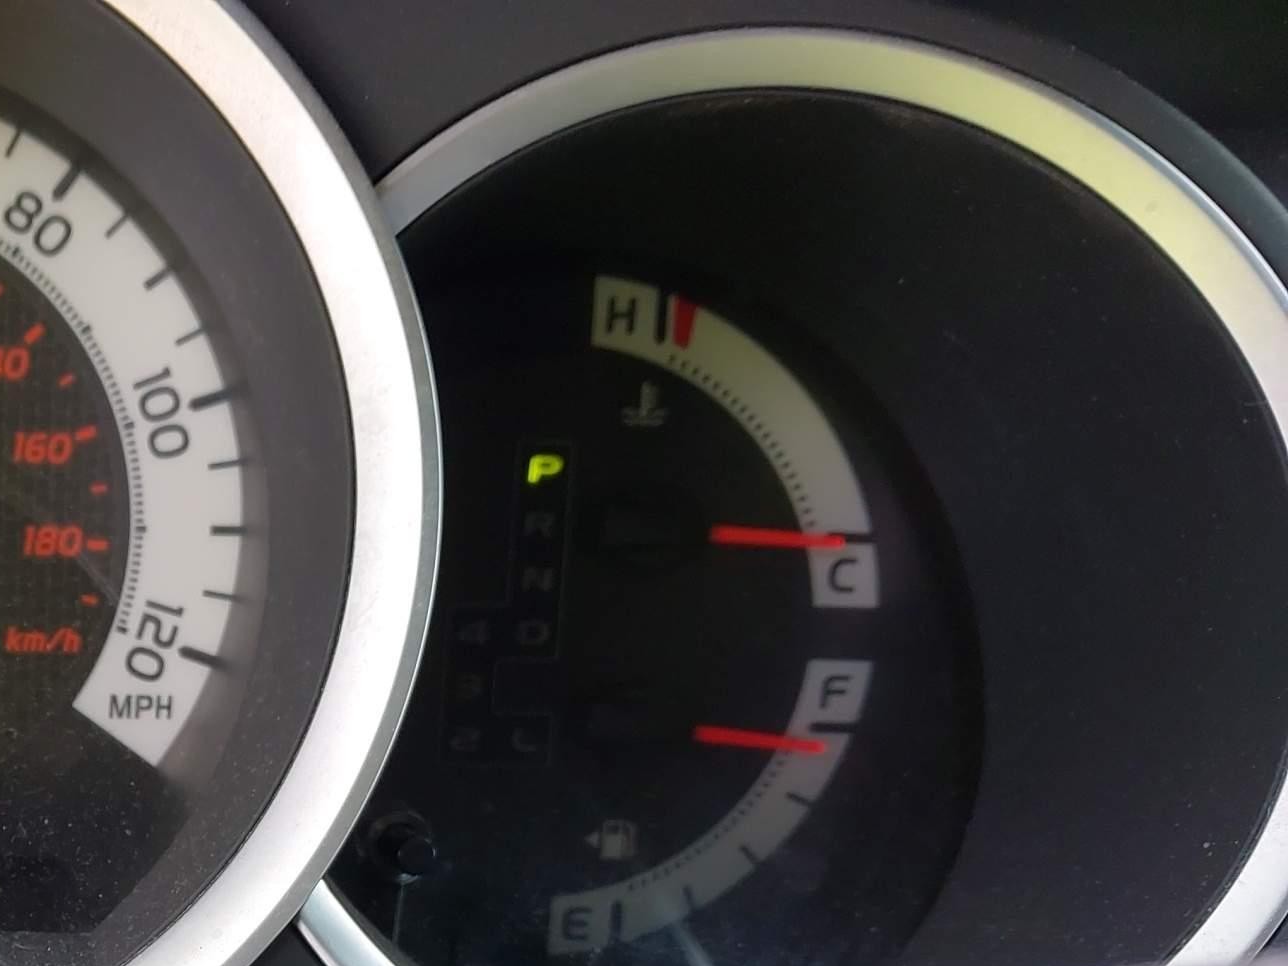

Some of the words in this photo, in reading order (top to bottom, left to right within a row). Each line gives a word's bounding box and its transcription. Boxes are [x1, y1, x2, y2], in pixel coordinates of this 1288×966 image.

[3, 192, 73, 257] 80
[605, 295, 637, 335] H
[132, 367, 190, 460] 100
[13, 430, 74, 464] 160
[528, 453, 564, 484] P
[23, 525, 83, 558] 180
[827, 557, 858, 593] C
[5, 627, 82, 653] km/h
[125, 600, 184, 682] 120
[109, 695, 172, 720] MPH
[819, 673, 852, 709] F
[561, 906, 593, 941] E
